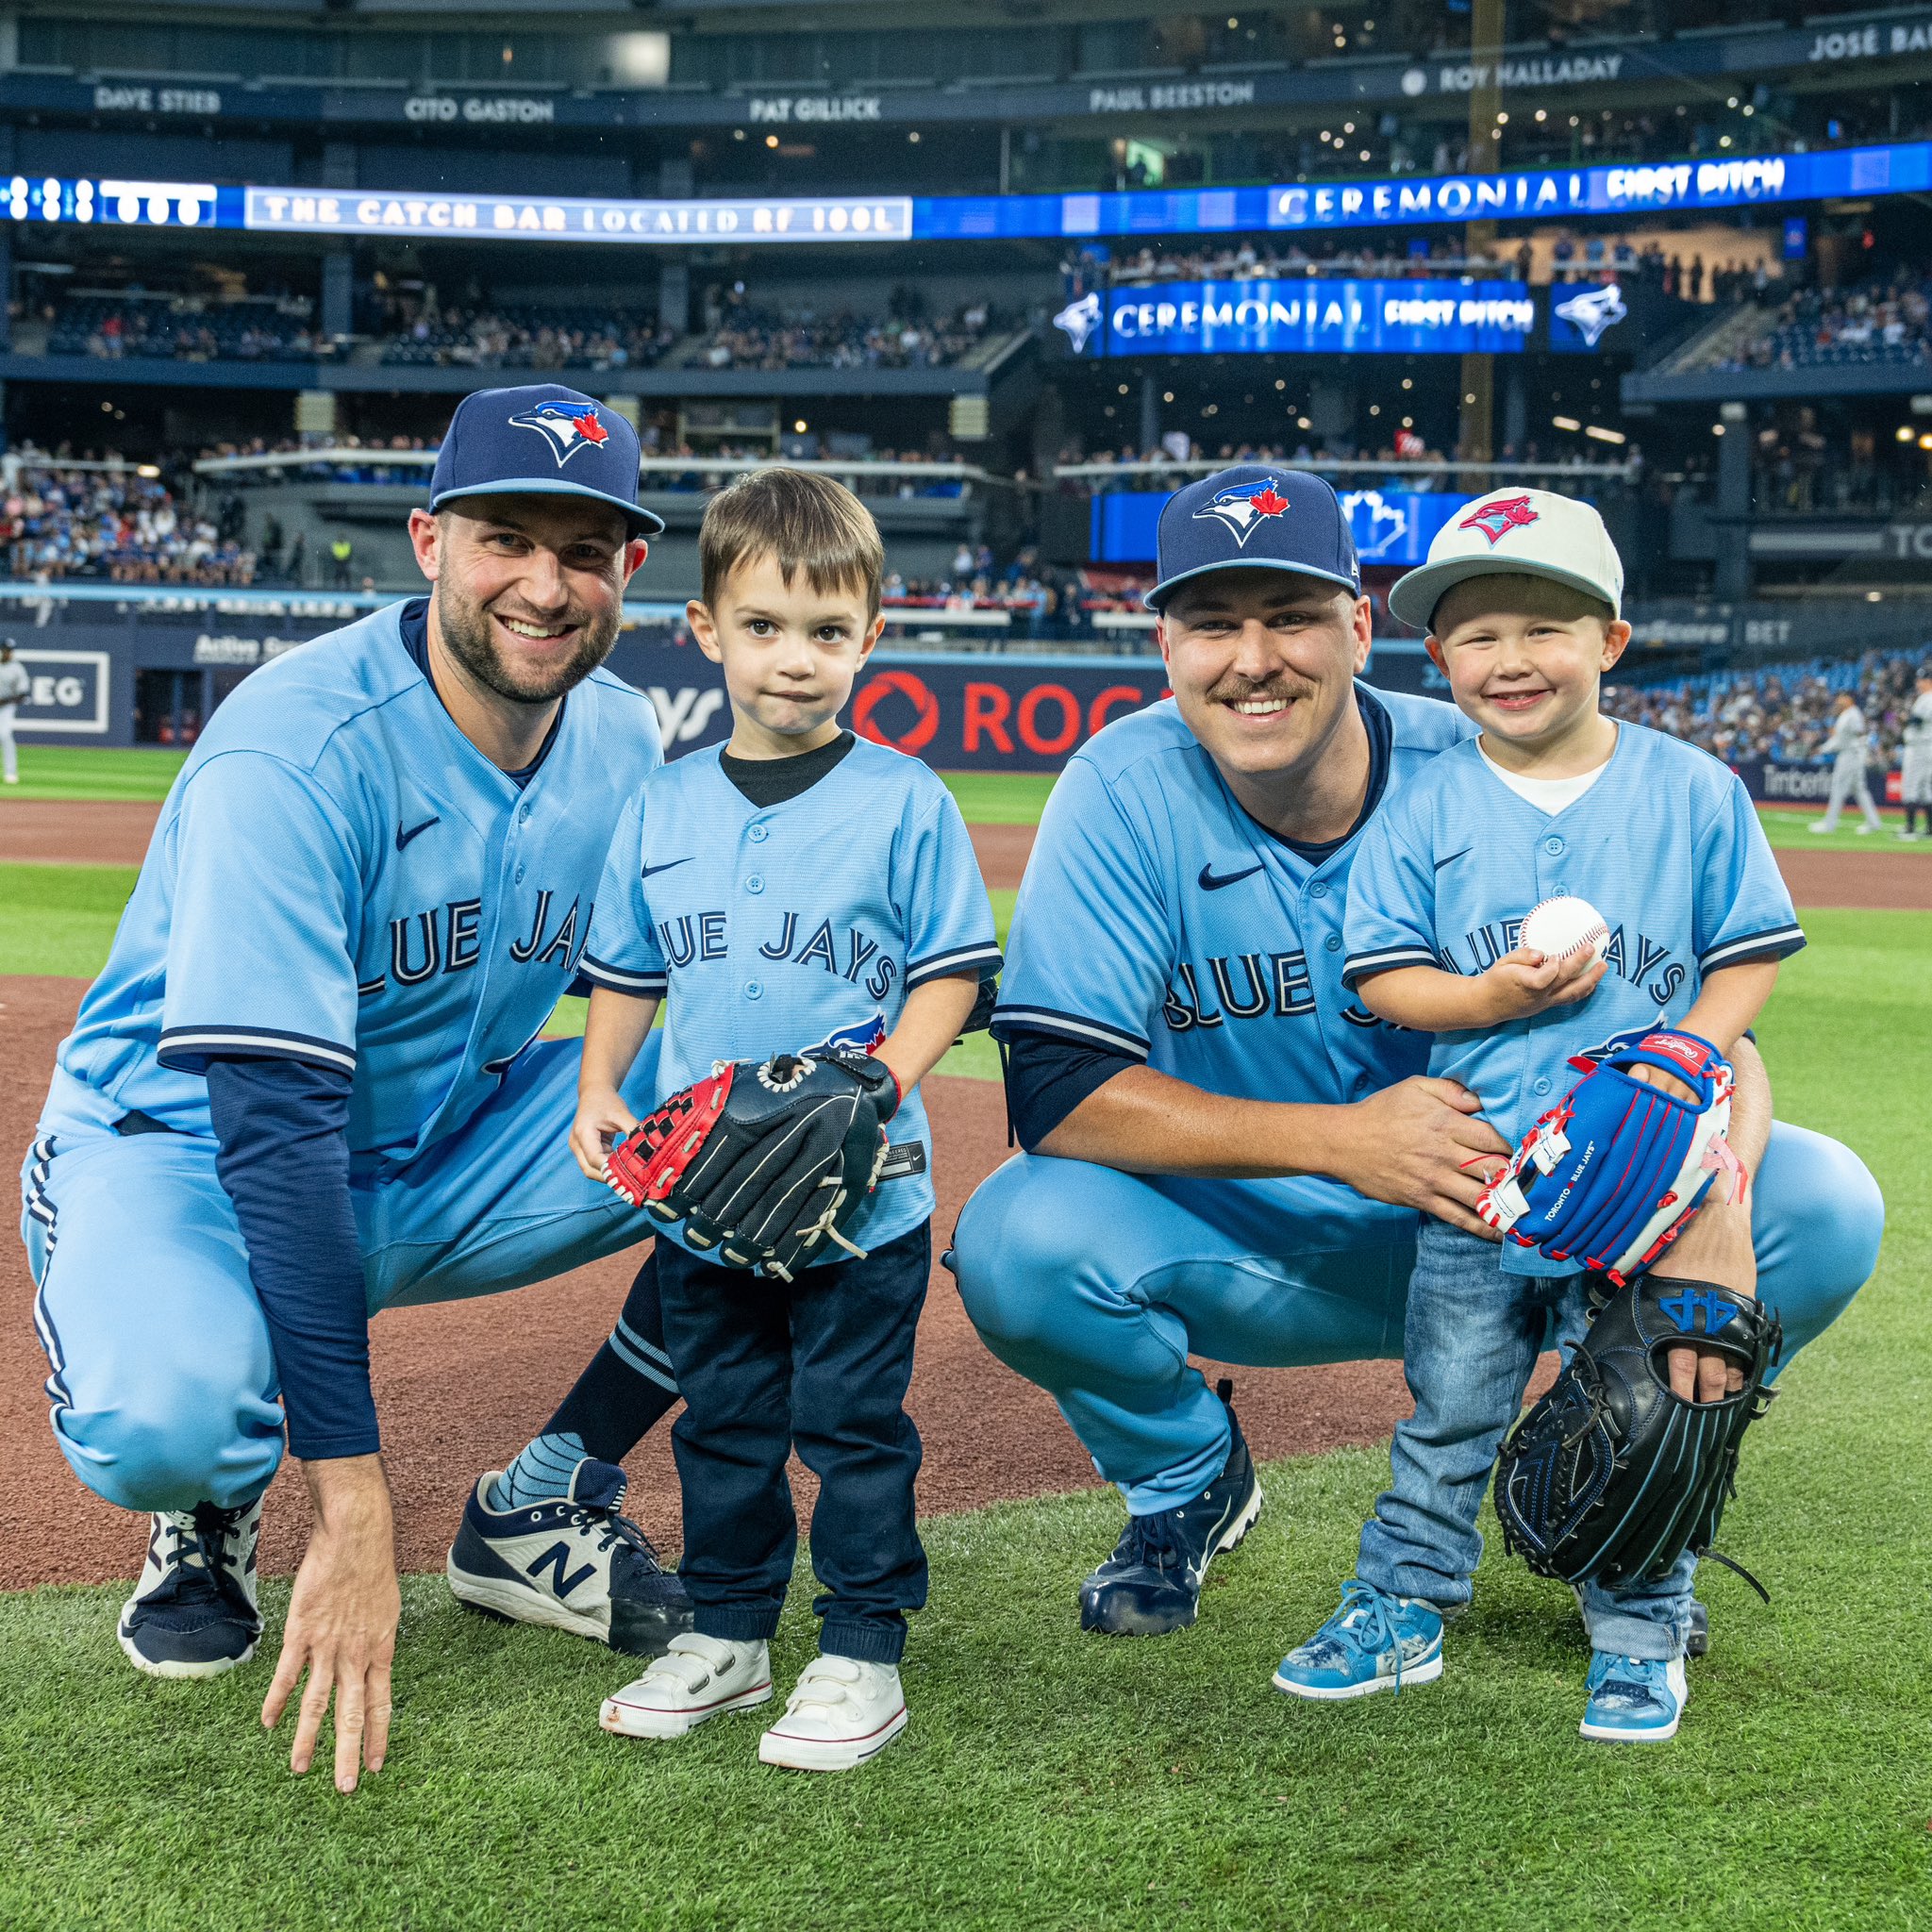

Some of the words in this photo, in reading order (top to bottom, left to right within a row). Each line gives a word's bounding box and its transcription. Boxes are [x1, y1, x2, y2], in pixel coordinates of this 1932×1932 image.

[1441, 65, 1490, 92] ROY
[1495, 54, 1623, 87] HALLADAY
[404, 96, 458, 122] CITO
[462, 97, 555, 124] GASTON
[749, 96, 792, 122] PAT
[264, 196, 341, 223] THE
[357, 199, 477, 228] CATCH
[493, 204, 566, 231] BAR
[1276, 172, 1590, 217] CEREMONIAL
[1112, 298, 1368, 338] CEREMONIAL
[758, 911, 897, 1001] JAYS
[1544, 1188, 1571, 1222] TORONTO
[1570, 1163, 1586, 1182] BLUE
